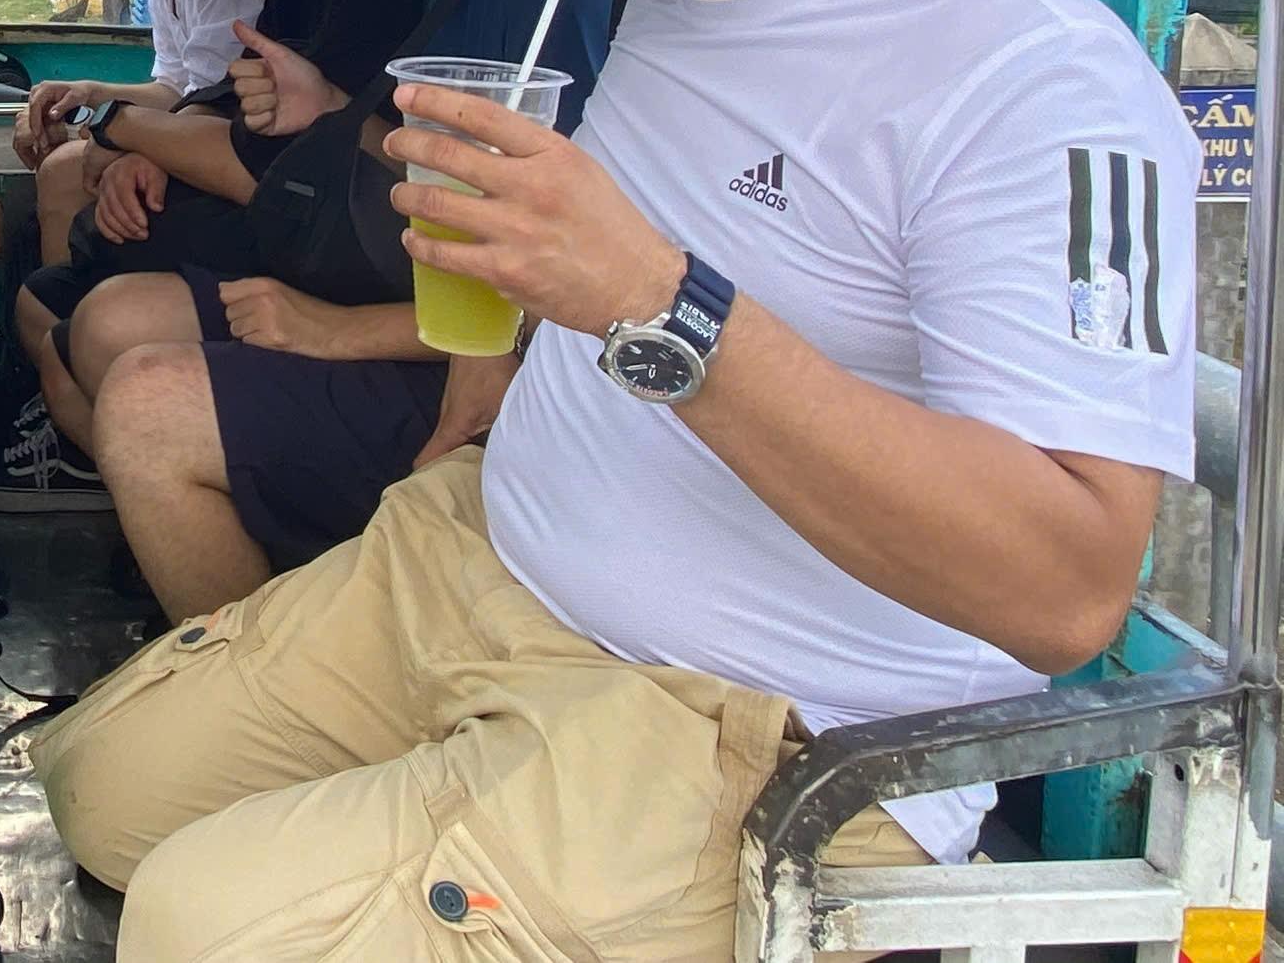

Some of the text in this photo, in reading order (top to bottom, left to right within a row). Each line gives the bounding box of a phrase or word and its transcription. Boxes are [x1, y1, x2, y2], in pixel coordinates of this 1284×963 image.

[1202, 138, 1238, 157] KHU
[729, 178, 788, 211] adidas
[676, 308, 715, 343] LACOSTE
